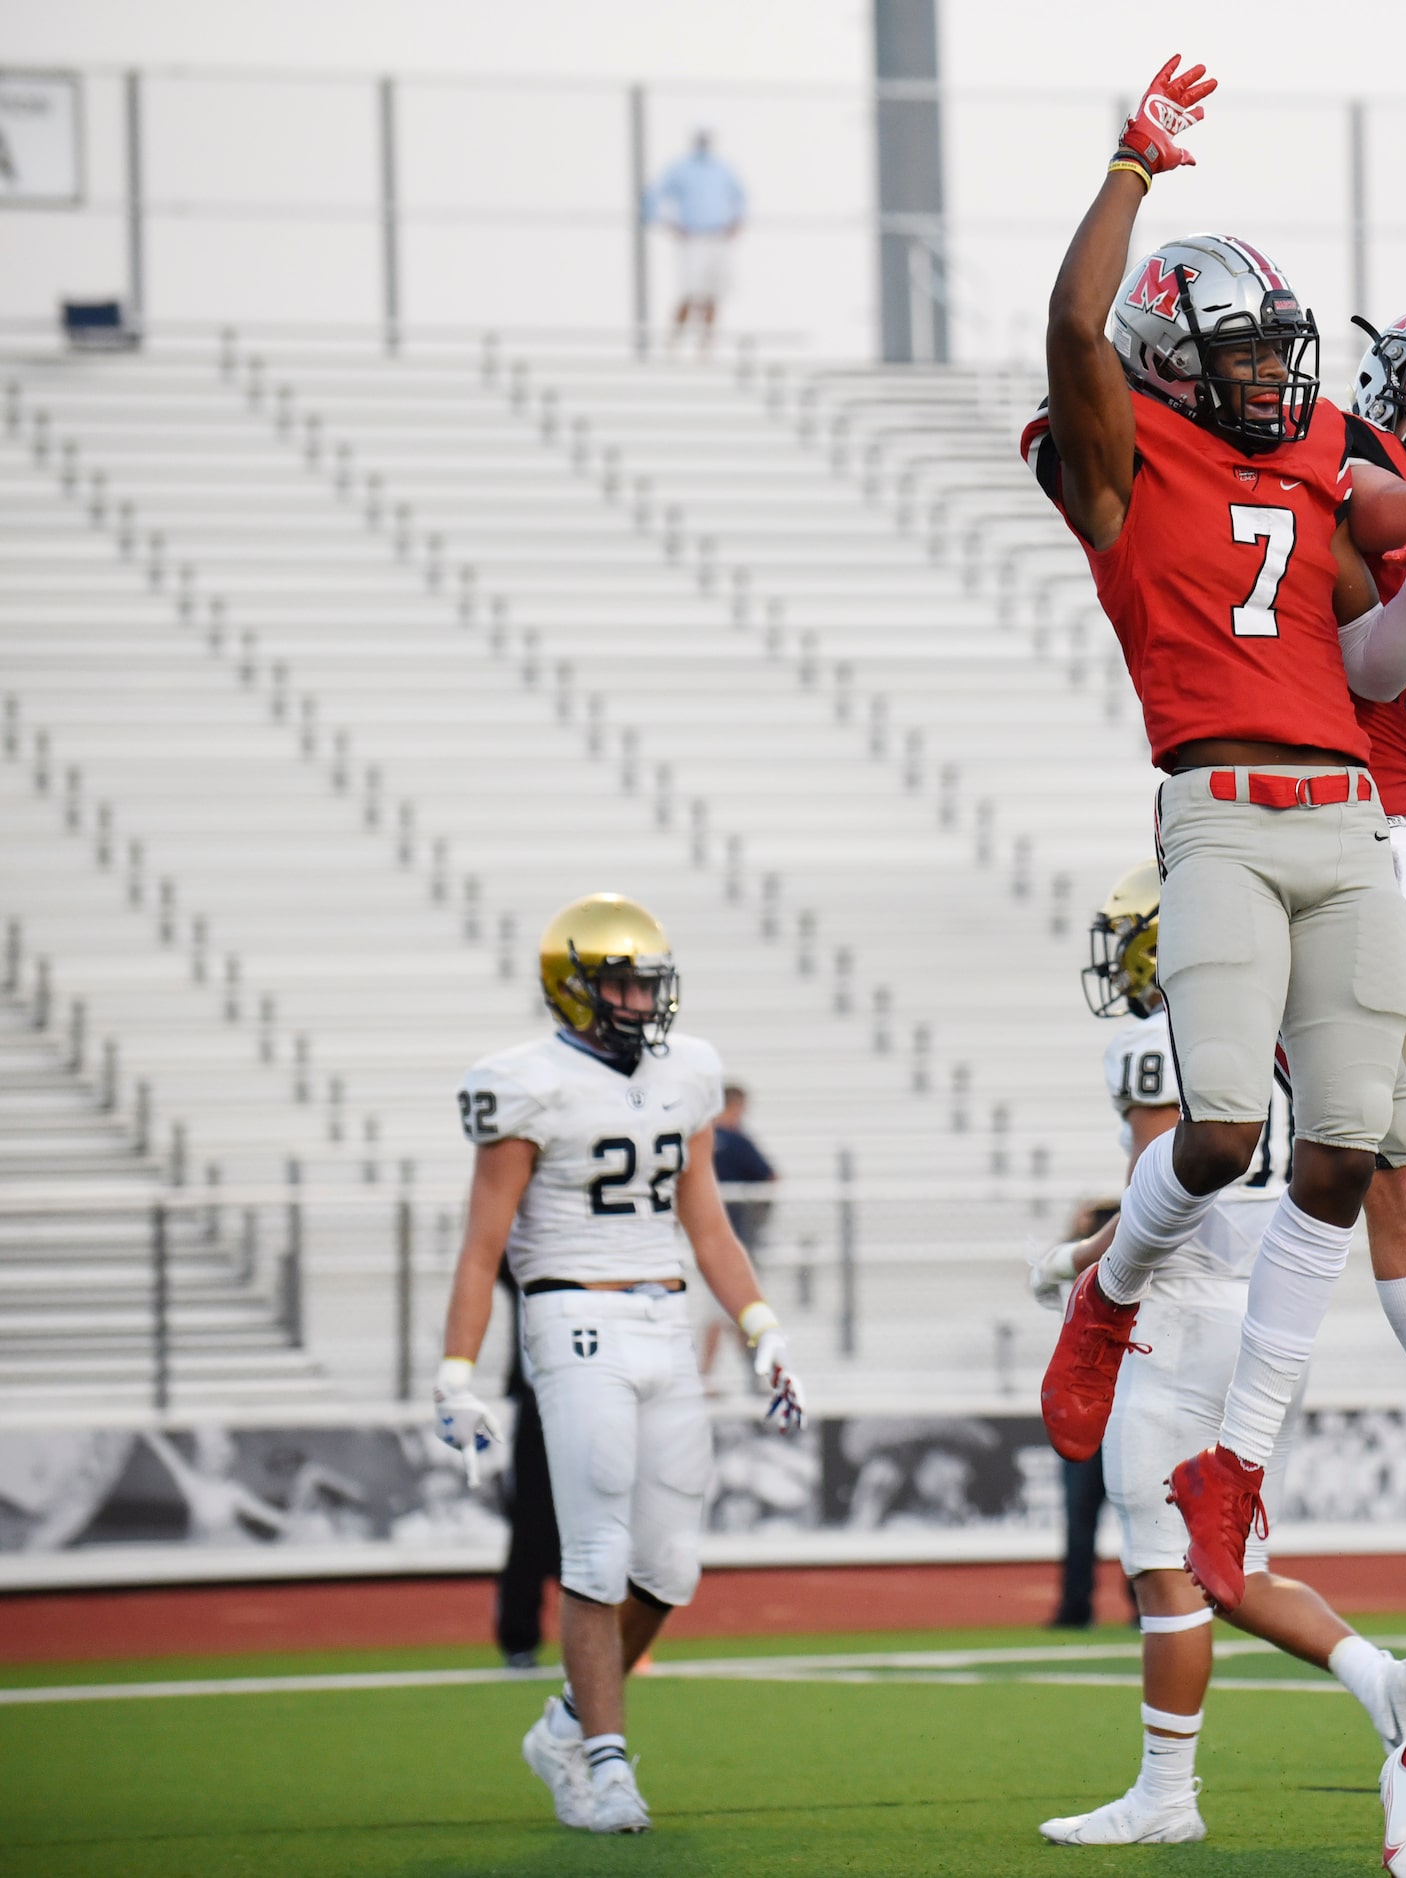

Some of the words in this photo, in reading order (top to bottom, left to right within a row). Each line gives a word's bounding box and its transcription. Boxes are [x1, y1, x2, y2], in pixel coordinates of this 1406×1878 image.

[1125, 256, 1201, 323] M
[1229, 503, 1296, 638] 7
[1118, 1051, 1165, 1099] 18
[587, 1131, 684, 1216] 22
